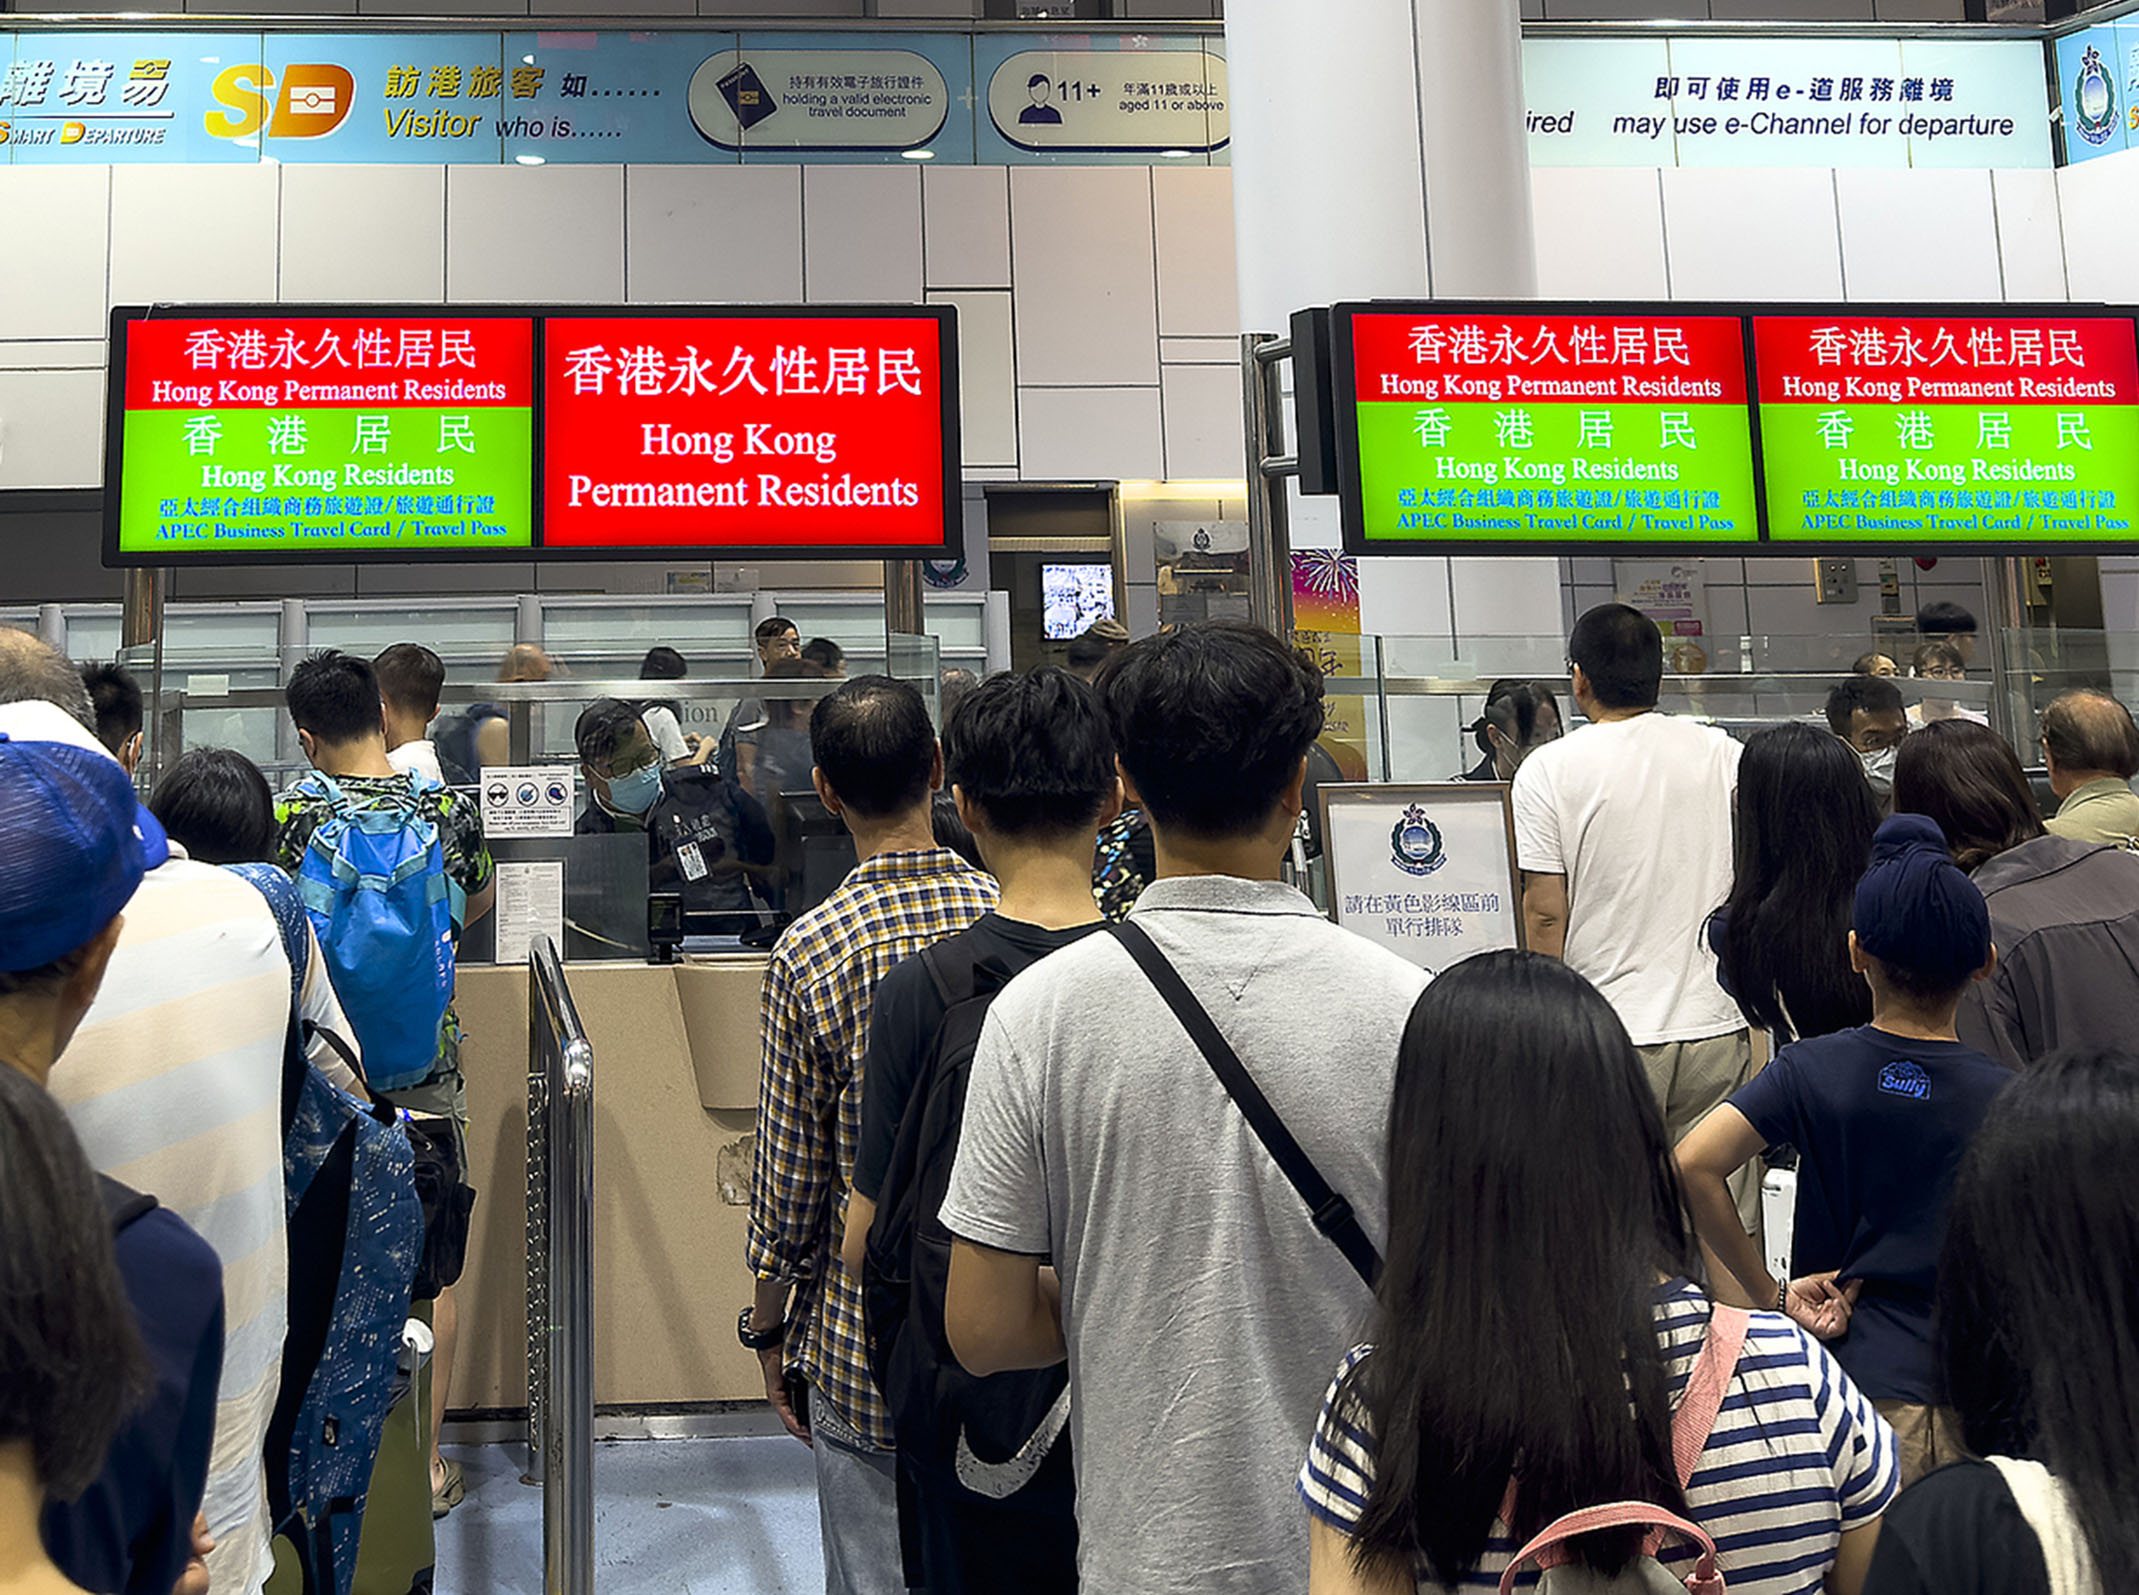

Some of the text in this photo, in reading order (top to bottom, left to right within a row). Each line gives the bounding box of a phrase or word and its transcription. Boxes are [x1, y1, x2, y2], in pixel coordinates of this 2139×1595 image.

[384, 65, 545, 98] 訪港旅客
[1057, 80, 1101, 101] 11+
[1654, 76, 1955, 102] 即可使用e-道服務離境
[204, 63, 356, 139] SD
[783, 93, 932, 106] holding a valid electronic
[808, 105, 906, 118] travel document
[1119, 100, 1224, 112] aged 11 or above
[60, 122, 166, 144] DEPARTURE
[384, 108, 481, 137] Visitor
[496, 117, 543, 137] who
[1612, 116, 1666, 139] may
[1673, 117, 1717, 134] use
[1725, 112, 1852, 135] e-Channel
[1860, 112, 1892, 135] for
[1898, 113, 2014, 141] departure
[184, 328, 476, 370] 香港永久性居民
[1407, 325, 1690, 366] 香港永久性居民
[1809, 327, 2085, 368] 香港永久性居民
[563, 345, 922, 396] 香港永久性居民
[153, 379, 506, 406] Hong Kong Permanent Residents
[1380, 374, 1722, 401] Hong Kong Permanent Residents
[1782, 376, 2116, 402] Hong Kong Permanent Residents
[641, 423, 837, 464] Hong Kong
[201, 463, 455, 493] Hong Kong Residents
[1435, 457, 1679, 485] Hong Kong Residents
[1838, 459, 2076, 486] Hong Kong Residents
[568, 473, 919, 508] Permanent Residents
[156, 520, 507, 540] APEC Business Travel Card / Travel Pass
[1397, 513, 1735, 533] APEC Business Travel Card / Travel Pass
[1802, 514, 2130, 530] APEC Business Travel Card / Travel Pass
[1385, 918, 1464, 937] 單行排隊
[1882, 1075, 1926, 1098] Sully
